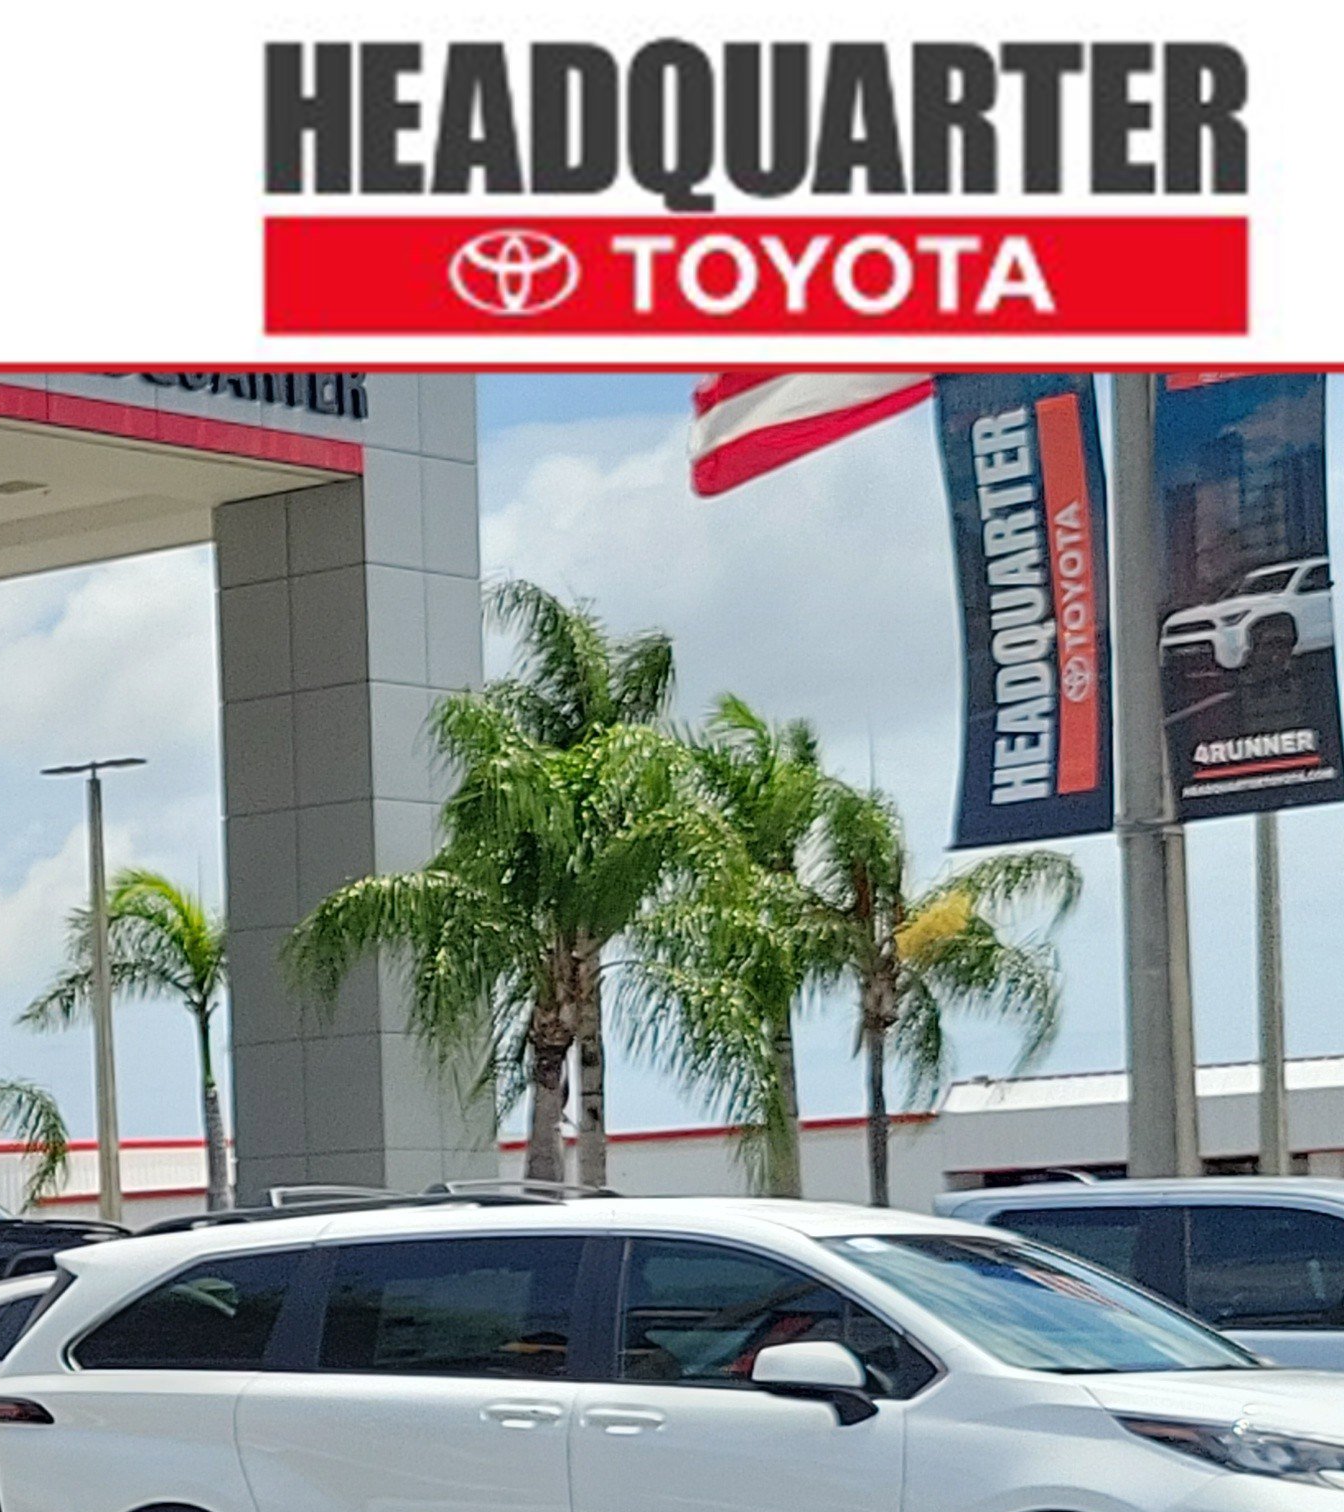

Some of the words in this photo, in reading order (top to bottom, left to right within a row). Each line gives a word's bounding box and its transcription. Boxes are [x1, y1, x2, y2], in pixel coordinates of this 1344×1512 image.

[971, 406, 1056, 806] HEADQUARTER
[1055, 500, 1088, 650] TOYOTA
[1193, 728, 1316, 764] 4RUNNER
